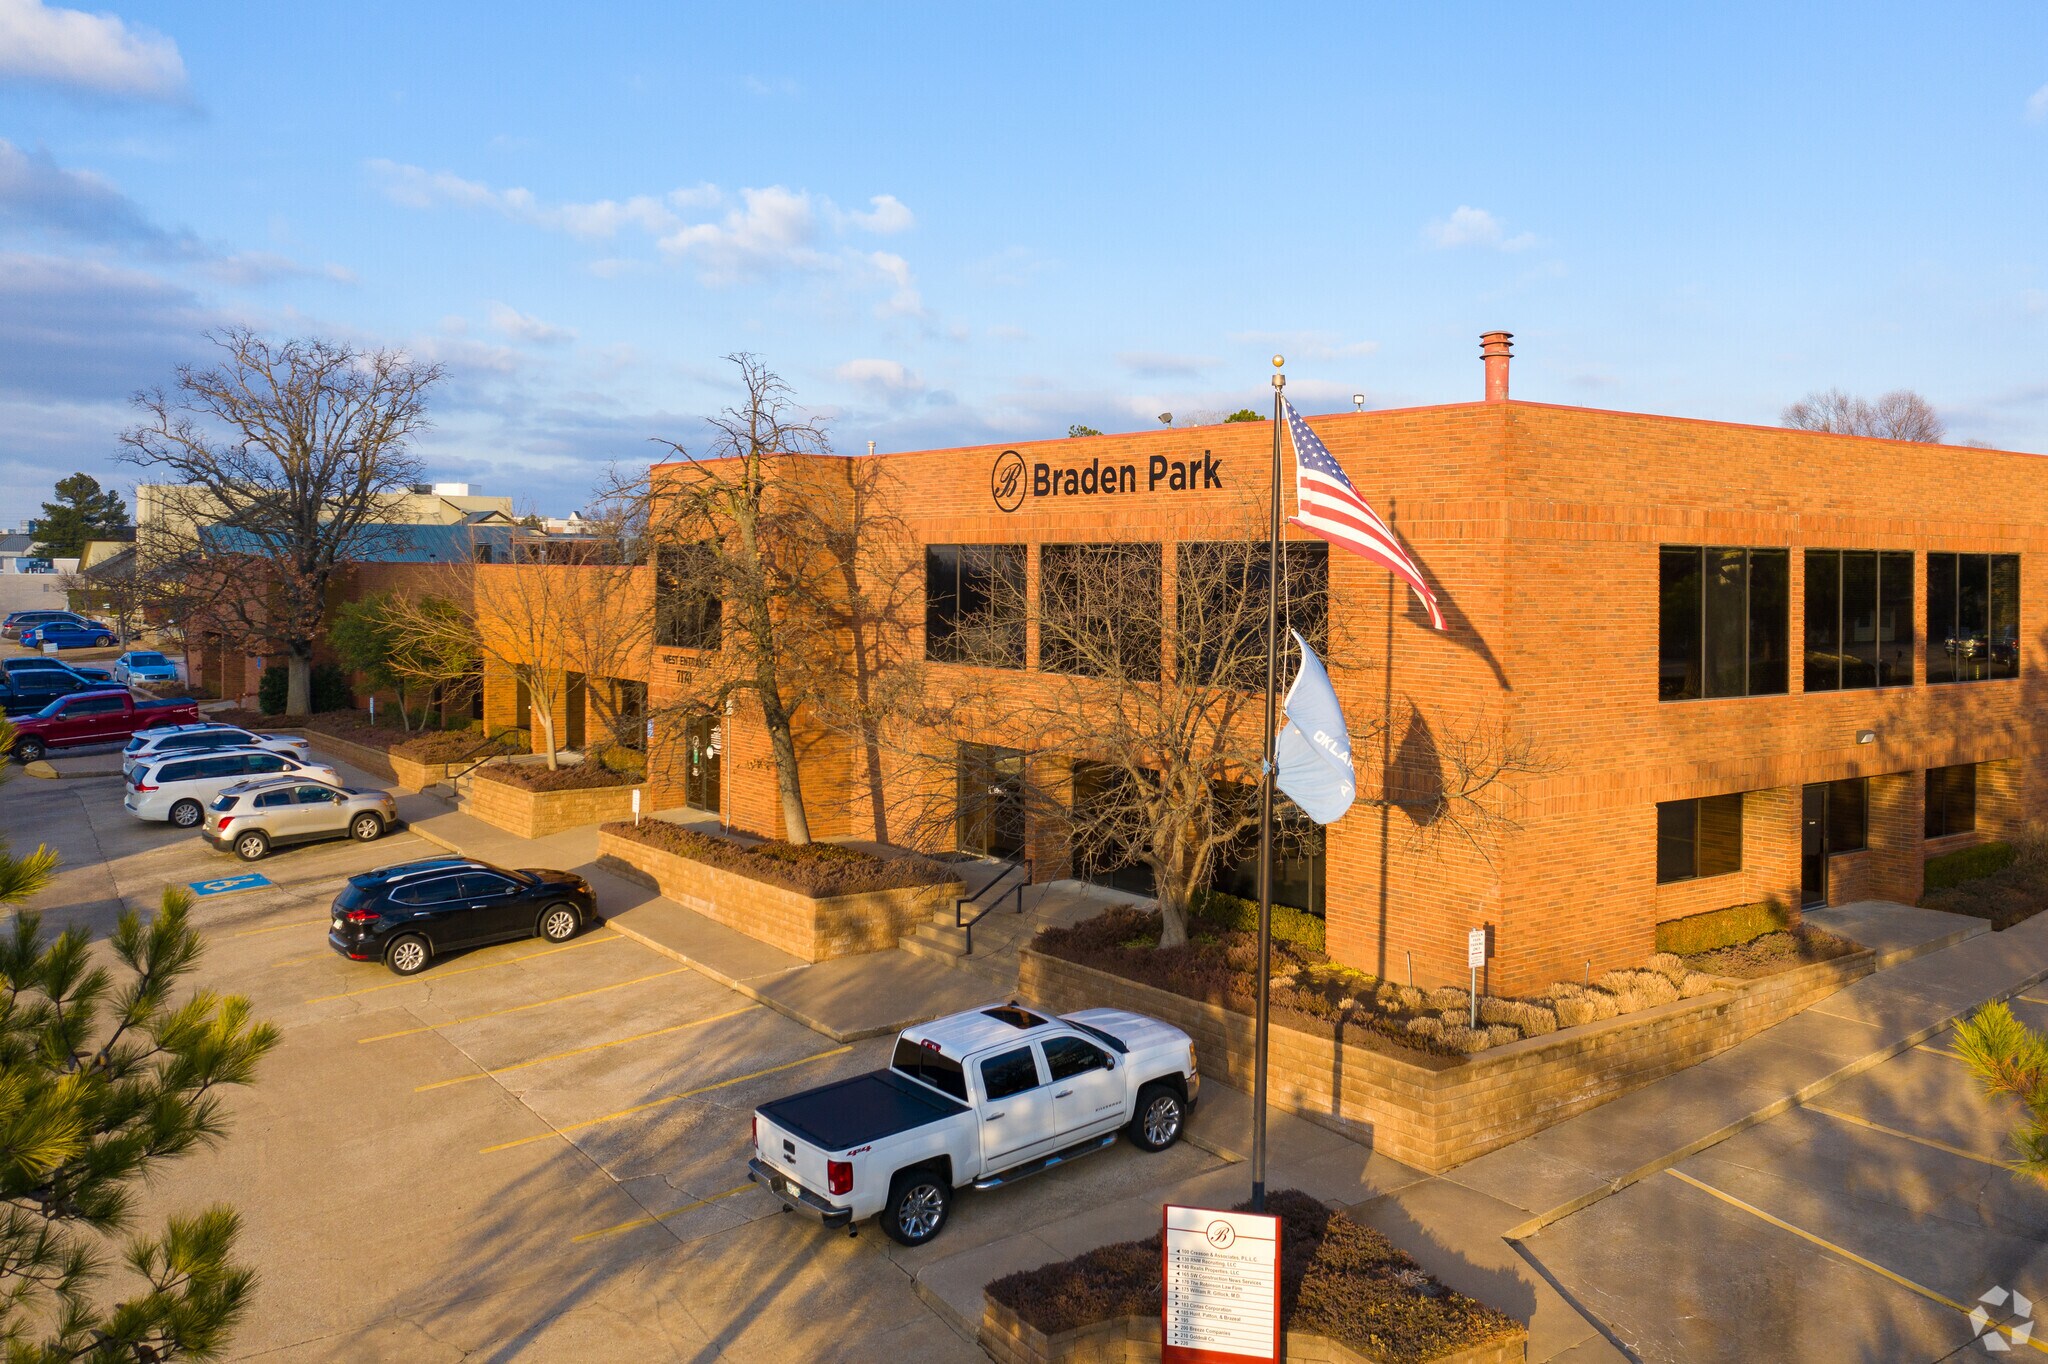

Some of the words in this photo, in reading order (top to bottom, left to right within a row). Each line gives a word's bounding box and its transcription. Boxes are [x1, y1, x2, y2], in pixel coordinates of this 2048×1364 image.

[1033, 458, 1136, 497] Braden
[1149, 450, 1223, 491] Park
[663, 655, 678, 665] WEST
